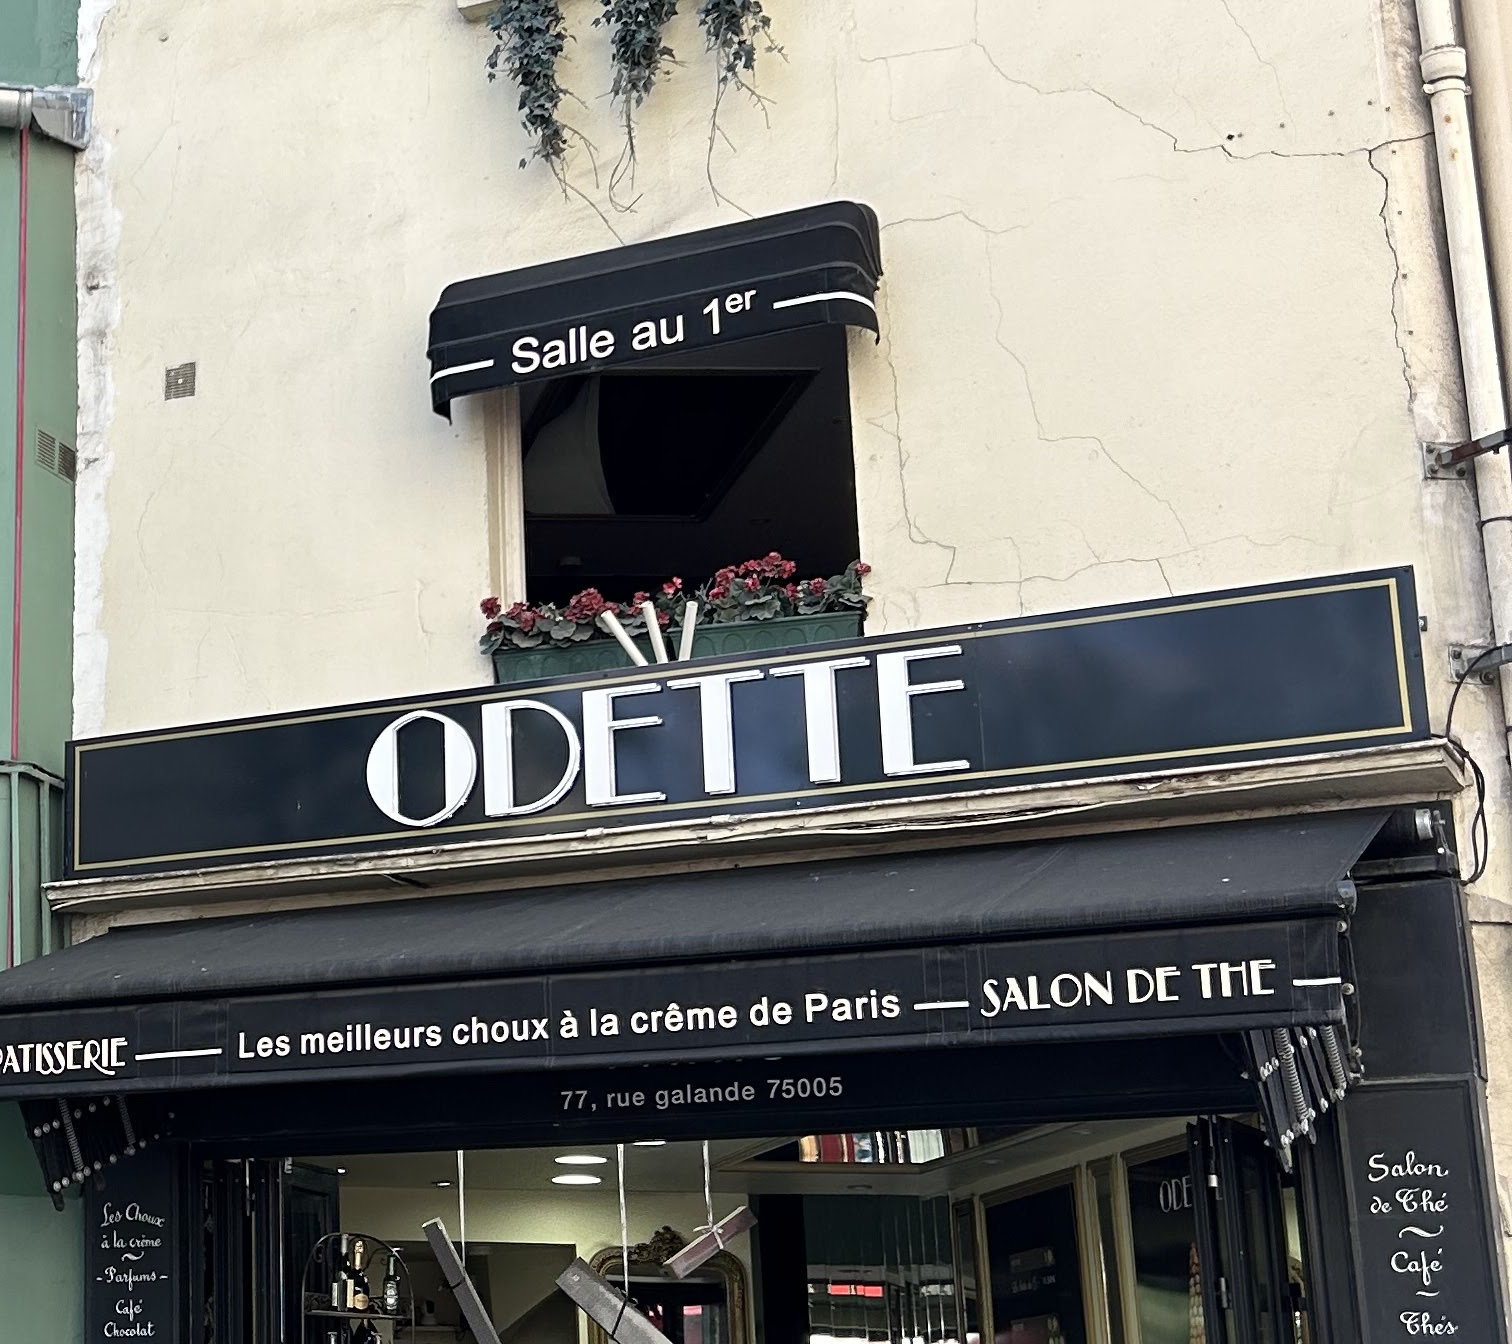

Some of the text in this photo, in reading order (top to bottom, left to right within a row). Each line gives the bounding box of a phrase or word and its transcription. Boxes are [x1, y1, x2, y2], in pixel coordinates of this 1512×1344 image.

[510, 288, 757, 375] Salle au 1er
[365, 644, 970, 828] ODETTE
[980, 958, 1277, 1018] SALON DE THE
[238, 1031, 291, 1060] Les
[300, 1022, 442, 1056] meilleurs
[452, 1014, 550, 1045] choux
[559, 1009, 579, 1040] à
[589, 1007, 619, 1037] la
[748, 996, 793, 1027] de
[805, 989, 901, 1023] Paris
[560, 1077, 844, 1111] 77, rue galande 75005
[1367, 1151, 1449, 1182] Salon
[100, 1202, 166, 1228] Les Choux
[1370, 1188, 1449, 1213] de Thé
[113, 1229, 128, 1249] la
[1390, 1247, 1443, 1286] Café
[115, 1298, 143, 1322] Café
[1399, 1311, 1458, 1335] Thés
[103, 1321, 155, 1337] Chocolat
